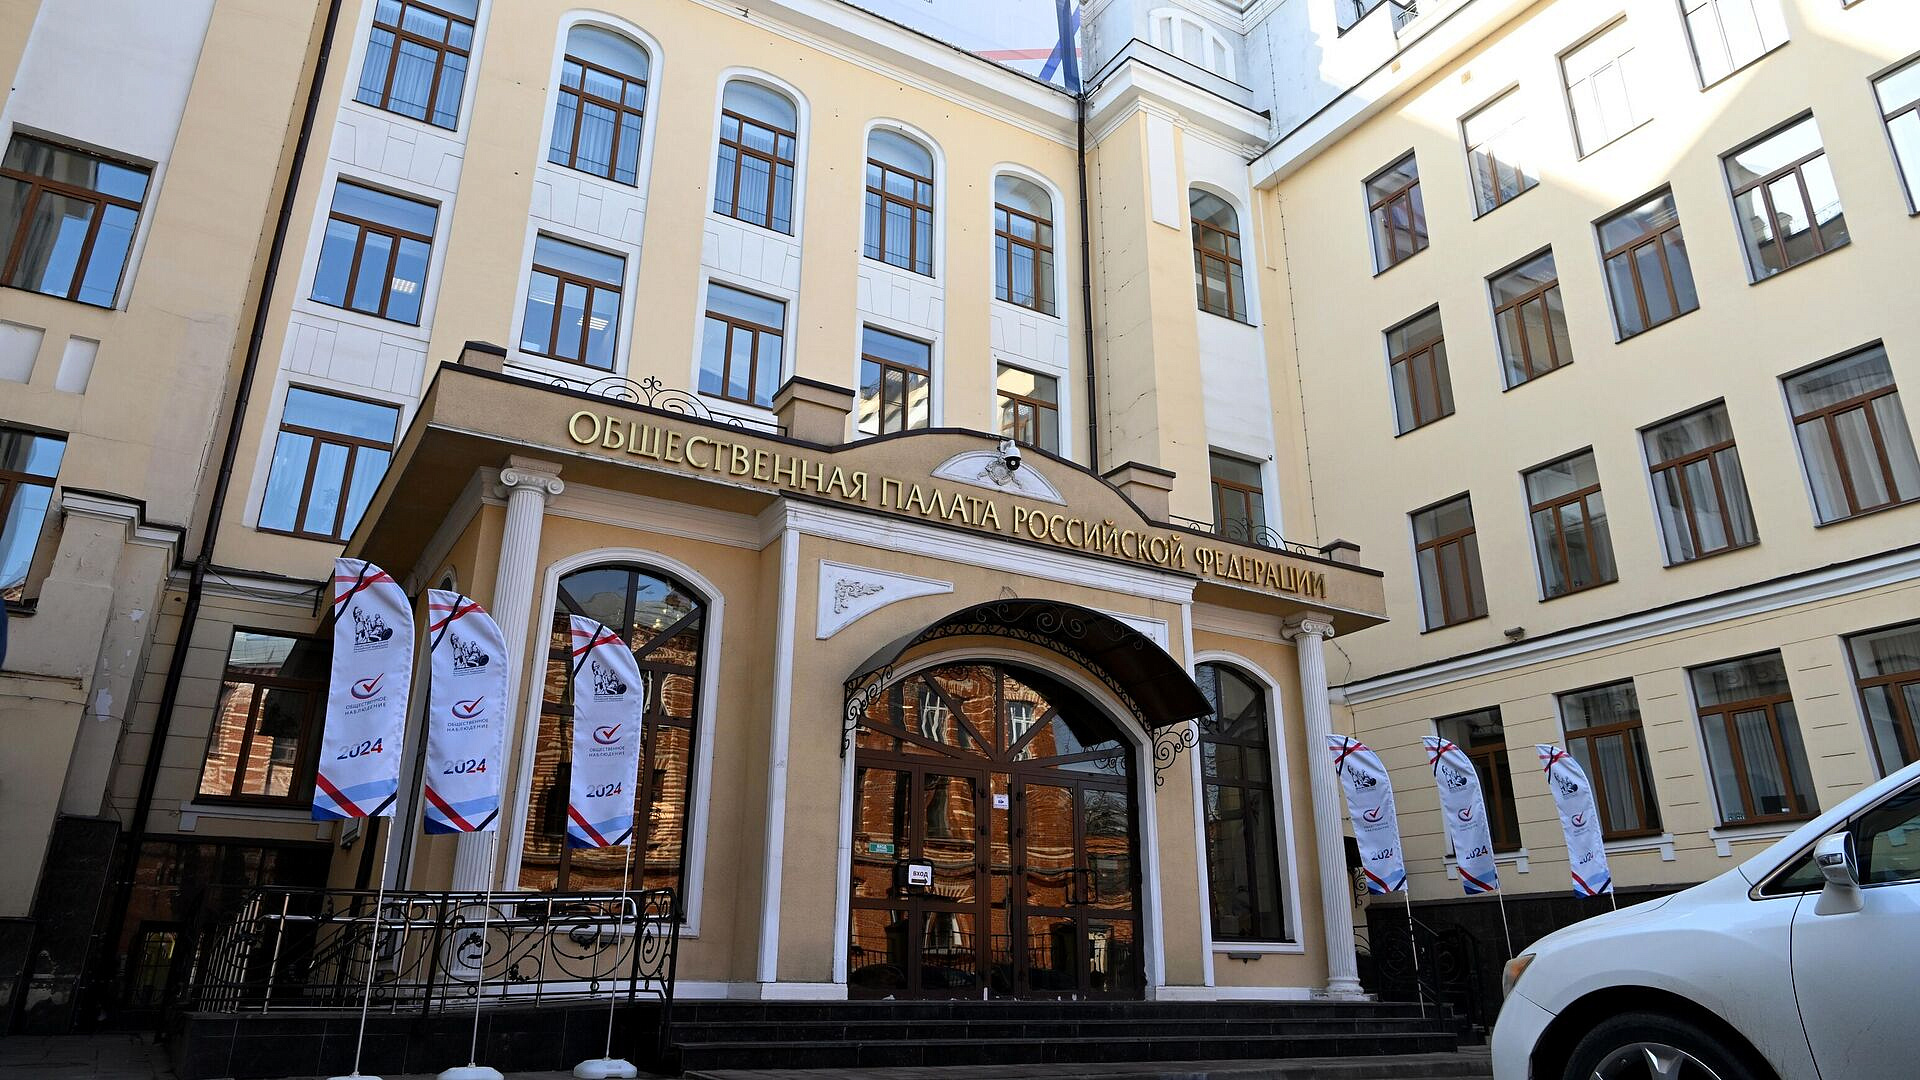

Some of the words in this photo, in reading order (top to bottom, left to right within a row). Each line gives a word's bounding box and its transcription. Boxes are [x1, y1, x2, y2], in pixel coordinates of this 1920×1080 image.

[568, 410, 869, 501] ОБЩЕСТВЕННАЯ
[881, 476, 1001, 530] ПАЛАТА
[1013, 505, 1186, 568] РОССИЙСКОЙ
[1194, 546, 1327, 598] ФЕДЕРАЦИИ
[337, 737, 383, 760] 2024
[444, 758, 487, 774] 2024
[586, 782, 622, 798] 2024
[912, 870, 928, 878] ВХОД
